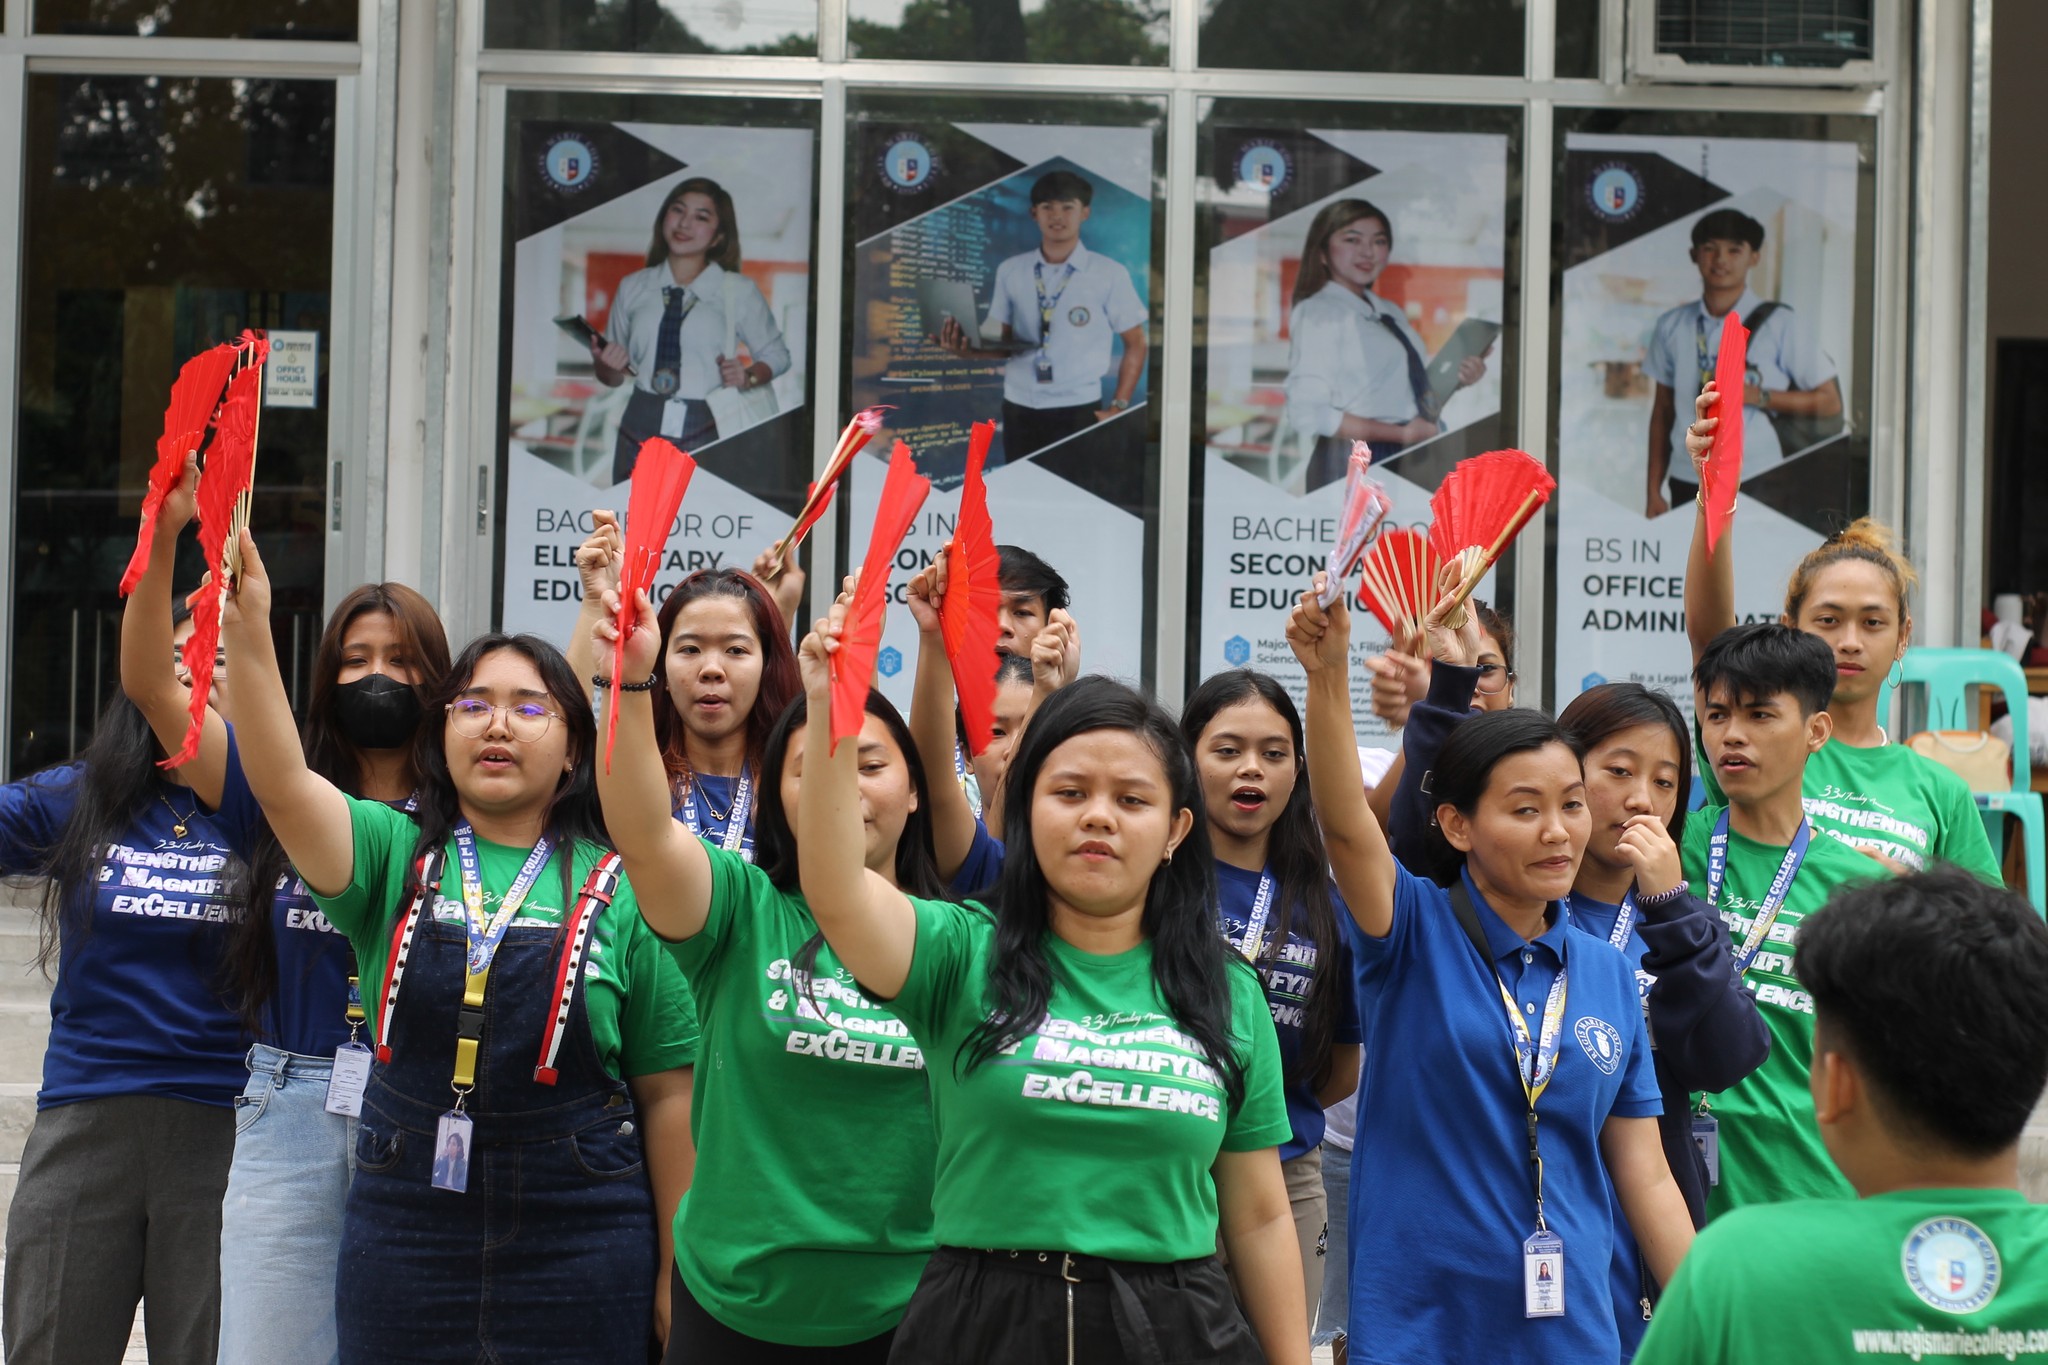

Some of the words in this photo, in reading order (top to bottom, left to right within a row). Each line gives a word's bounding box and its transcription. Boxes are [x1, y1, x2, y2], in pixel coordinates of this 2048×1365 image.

[712, 515, 754, 539] OF
[927, 513, 957, 536] IN
[1586, 538, 1622, 563] BS
[1633, 539, 1661, 563] IN
[1583, 574, 1683, 598] OFFICE
[731, 777, 750, 823] COLLEGE
[1711, 833, 1728, 845] RMC
[1251, 875, 1271, 920] COLLEGE
[1738, 927, 1760, 961] REGIS
[1769, 848, 1797, 896] COLLEGE
[768, 989, 788, 1011] &
[1021, 1070, 1219, 1123] EXCELLENCE
